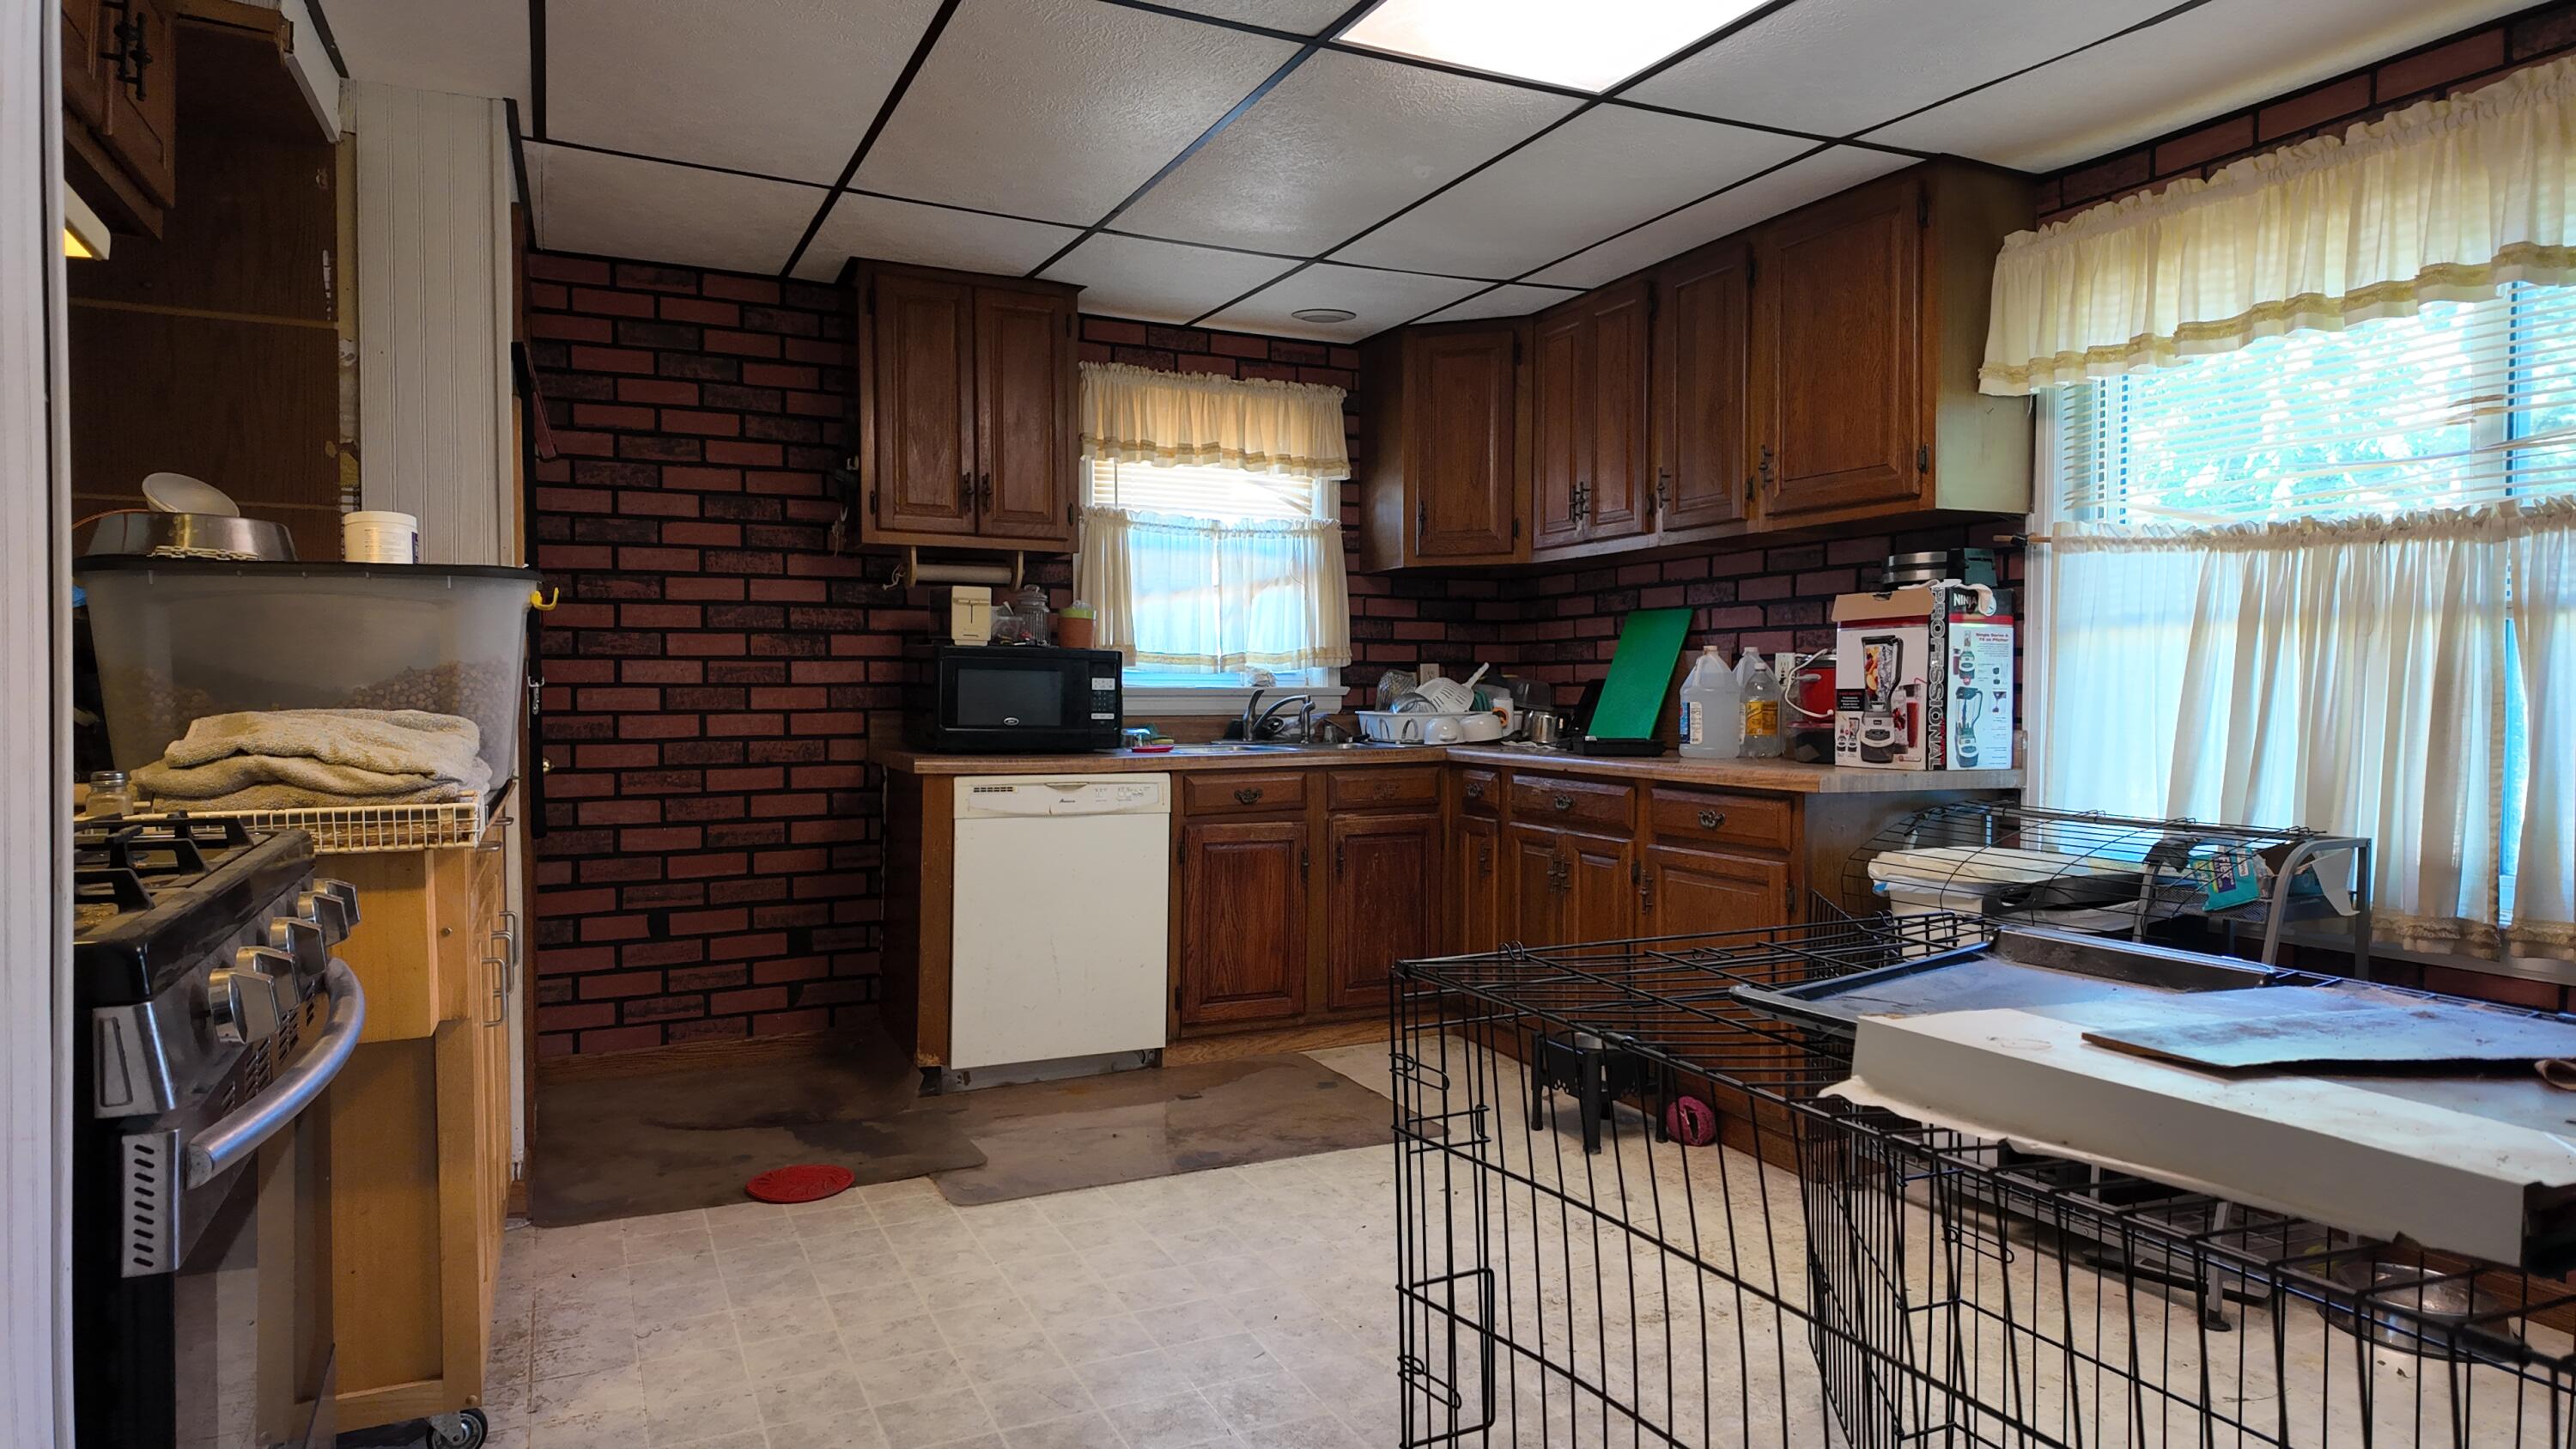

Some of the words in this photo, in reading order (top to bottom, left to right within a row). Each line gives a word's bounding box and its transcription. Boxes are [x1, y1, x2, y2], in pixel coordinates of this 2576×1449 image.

[1953, 593, 1978, 608] NINJA
[1929, 587, 1945, 770] PROFESSIONAL
[2218, 856, 2232, 879] Flex
